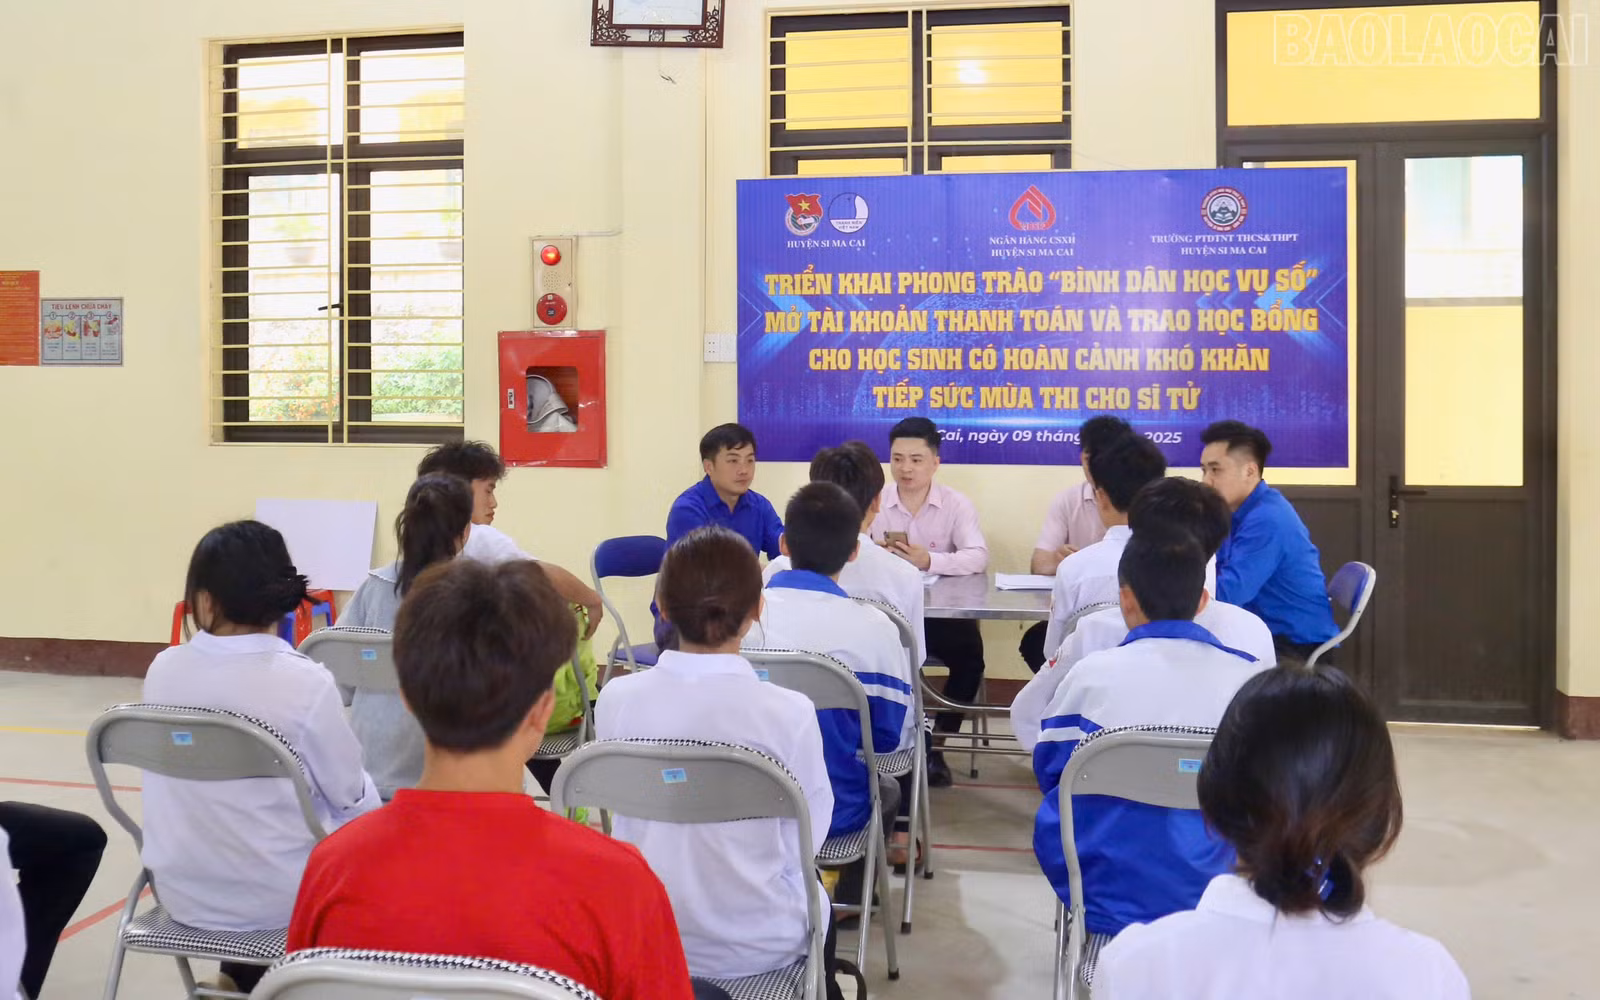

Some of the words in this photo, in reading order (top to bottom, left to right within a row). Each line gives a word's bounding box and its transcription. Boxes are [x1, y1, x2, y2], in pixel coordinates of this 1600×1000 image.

[787, 239, 819, 250] HUYỆN
[820, 240, 830, 248] SI
[831, 240, 847, 248] MA
[849, 239, 866, 248] CAI
[989, 235, 1017, 245] NGÂN
[1020, 235, 1047, 245] HÀNG
[1049, 236, 1076, 244] CSXH
[1151, 233, 1192, 243] TRƯỜNG
[1195, 235, 1235, 243] PTDTNT
[1236, 234, 1299, 242] THCS&THPT
[991, 247, 1025, 258] HUYỆN
[1056, 248, 1074, 256] CAI
[1181, 246, 1217, 257] HUYỆN
[1218, 247, 1228, 255] SI
[1230, 247, 1246, 255] MA
[1248, 246, 1267, 255] CAI
[764, 264, 832, 296] TRIỂN
[838, 272, 892, 294] KHAI
[898, 271, 976, 294] PHONG
[982, 266, 1043, 294] TRÀO
[1049, 266, 1120, 293] “BÌNH
[1126, 265, 1177, 293] DÂN
[1183, 269, 1230, 296] HỌC
[1236, 269, 1269, 296] VỤ
[1275, 261, 1319, 292] SỐ”
[764, 305, 803, 333] MỞ
[808, 307, 844, 333] TÀI
[850, 304, 928, 332] KHOẢN
[934, 310, 1014, 332] THANH
[1020, 305, 1084, 332] TOÁN
[1090, 305, 1122, 332] VÀ
[1128, 309, 1191, 332] TRAO
[1197, 309, 1244, 335] HỌC
[1250, 300, 1318, 332] BỔNG
[809, 348, 852, 370] CHO
[858, 348, 901, 374] HỌC
[907, 348, 963, 370] SINH
[969, 344, 997, 370] CÓ
[1003, 344, 1069, 371] HOÀN
[1075, 342, 1139, 371] CẢNH
[1146, 344, 1194, 371] KHÓ
[1201, 344, 1270, 371] KHĂN
[873, 378, 924, 409] TIẾP
[930, 382, 974, 409] SỨC
[979, 382, 1034, 409] MÙA
[1040, 387, 1079, 410] THI
[1085, 387, 1130, 410] CHO
[1137, 383, 1160, 410] SĨ
[1167, 381, 1202, 410] TỬ
[968, 429, 1009, 444] ngày
[1012, 430, 1032, 442] 09
[1036, 430, 1080, 445] tháng
